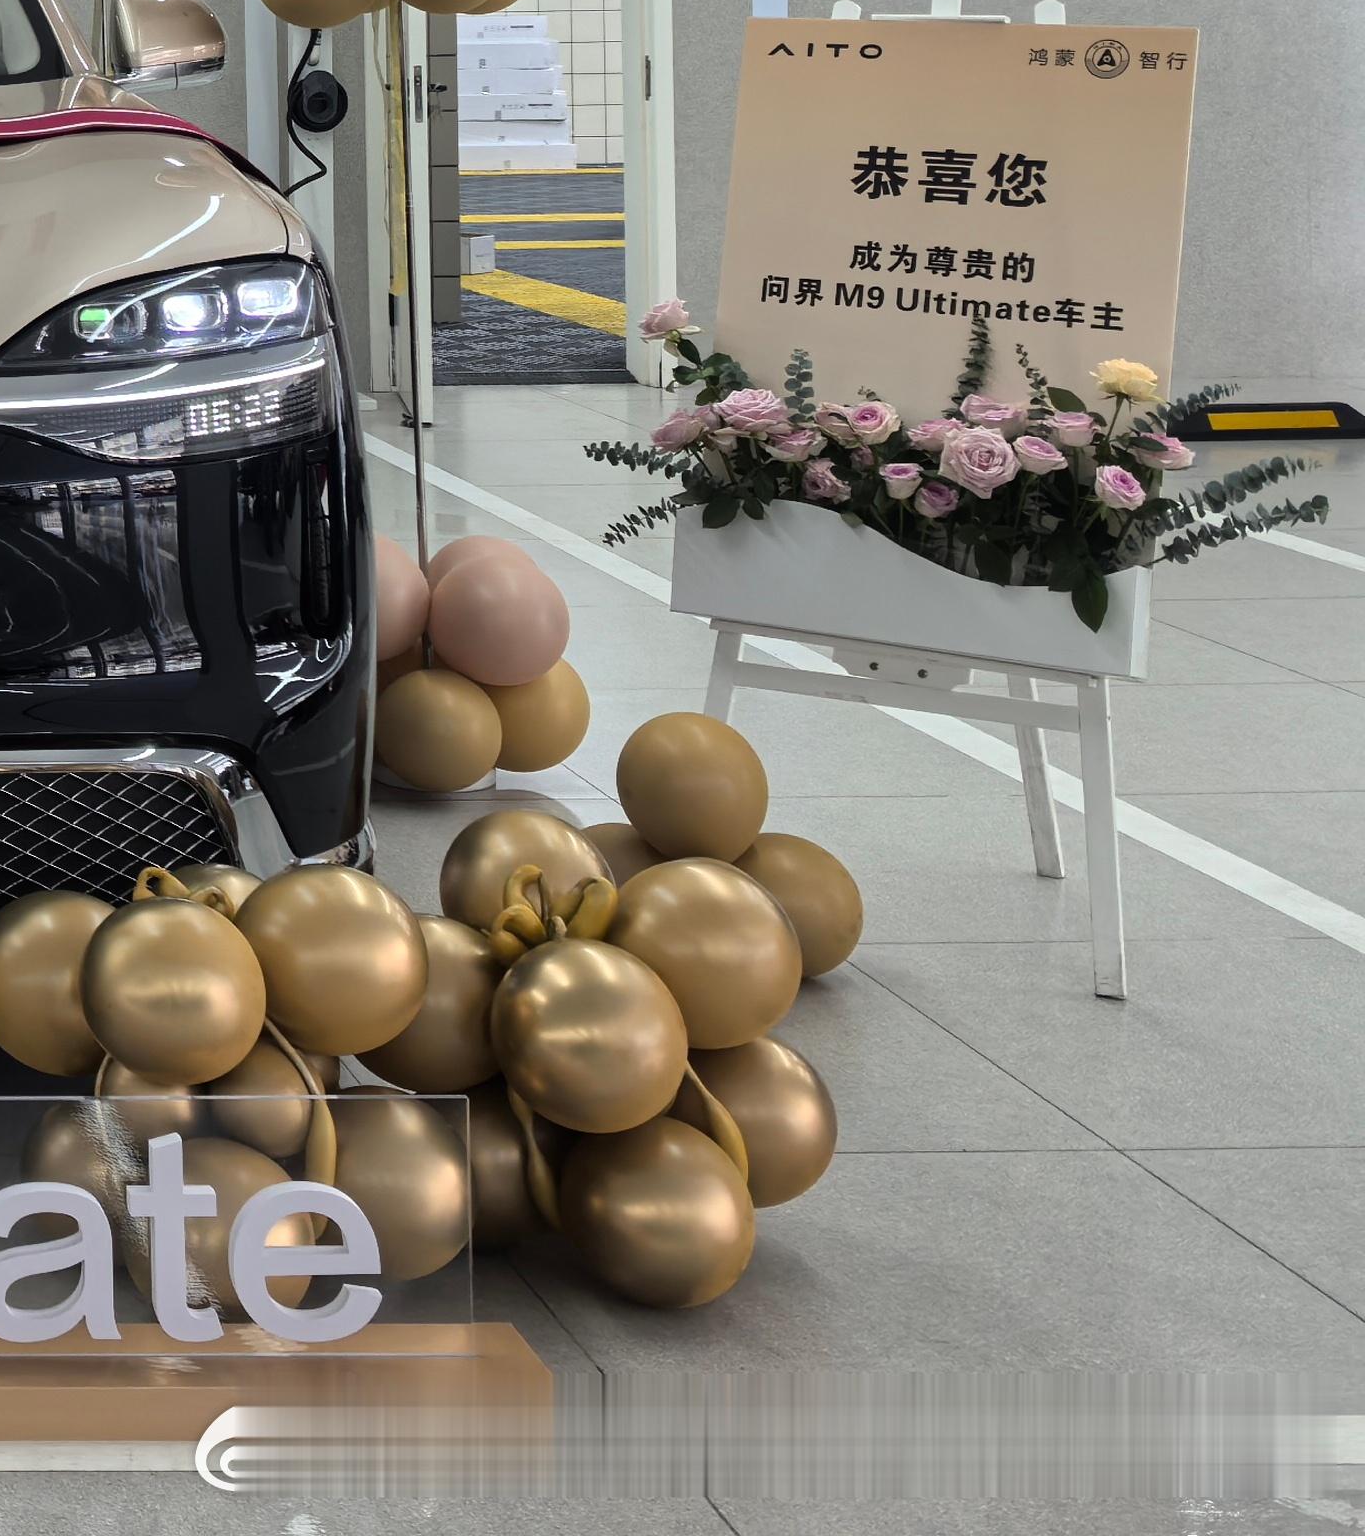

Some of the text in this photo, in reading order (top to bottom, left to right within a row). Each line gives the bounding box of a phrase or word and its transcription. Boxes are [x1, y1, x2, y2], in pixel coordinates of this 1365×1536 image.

[768, 43, 882, 59] AITO
[1028, 47, 1188, 71] 鸿蒙 智行
[851, 146, 1048, 207] 恭喜您
[849, 241, 1035, 283] 成为尊贵的
[760, 274, 824, 307] 问界
[834, 282, 885, 309] M9
